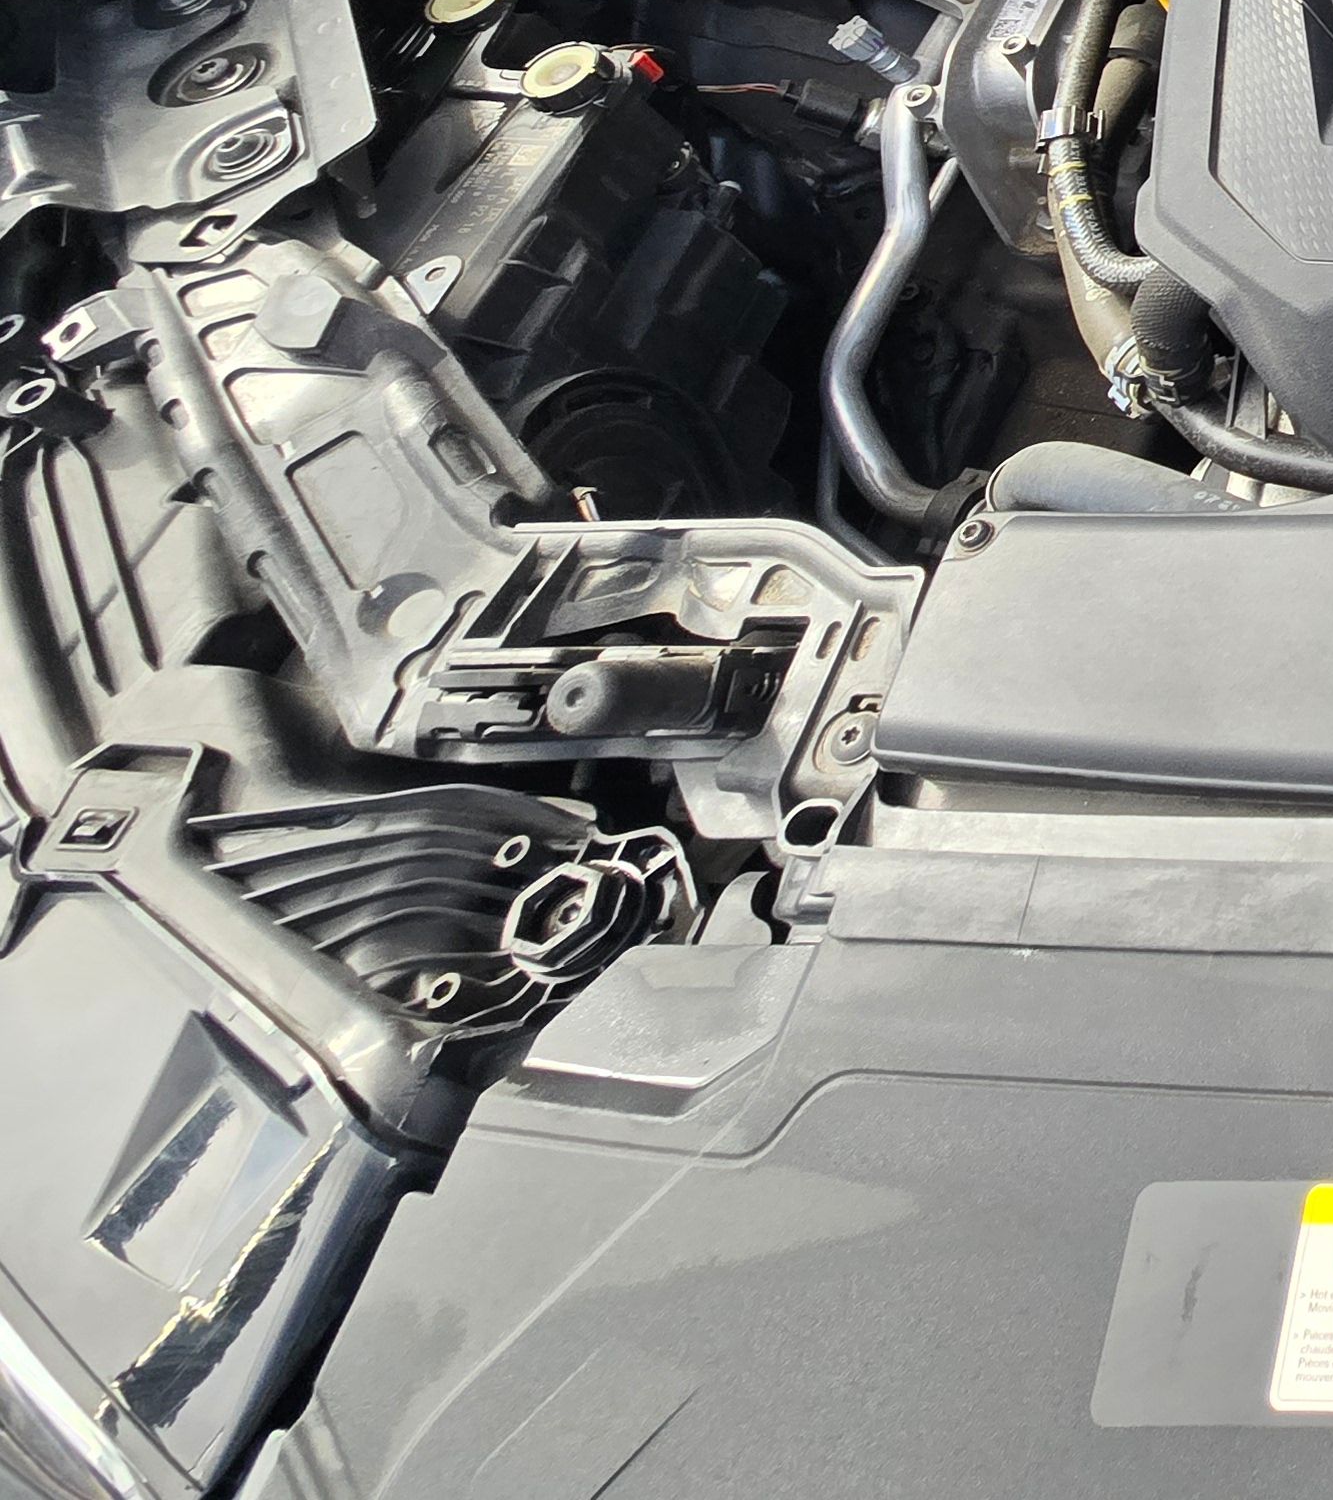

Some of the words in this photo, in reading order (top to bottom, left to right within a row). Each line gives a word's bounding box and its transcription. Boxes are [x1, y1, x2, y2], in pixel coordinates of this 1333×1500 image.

[1310, 1289, 1328, 1299] Hot
[1303, 1328, 1333, 1340] Pièces
[1298, 1357, 1329, 1368] Pièces
